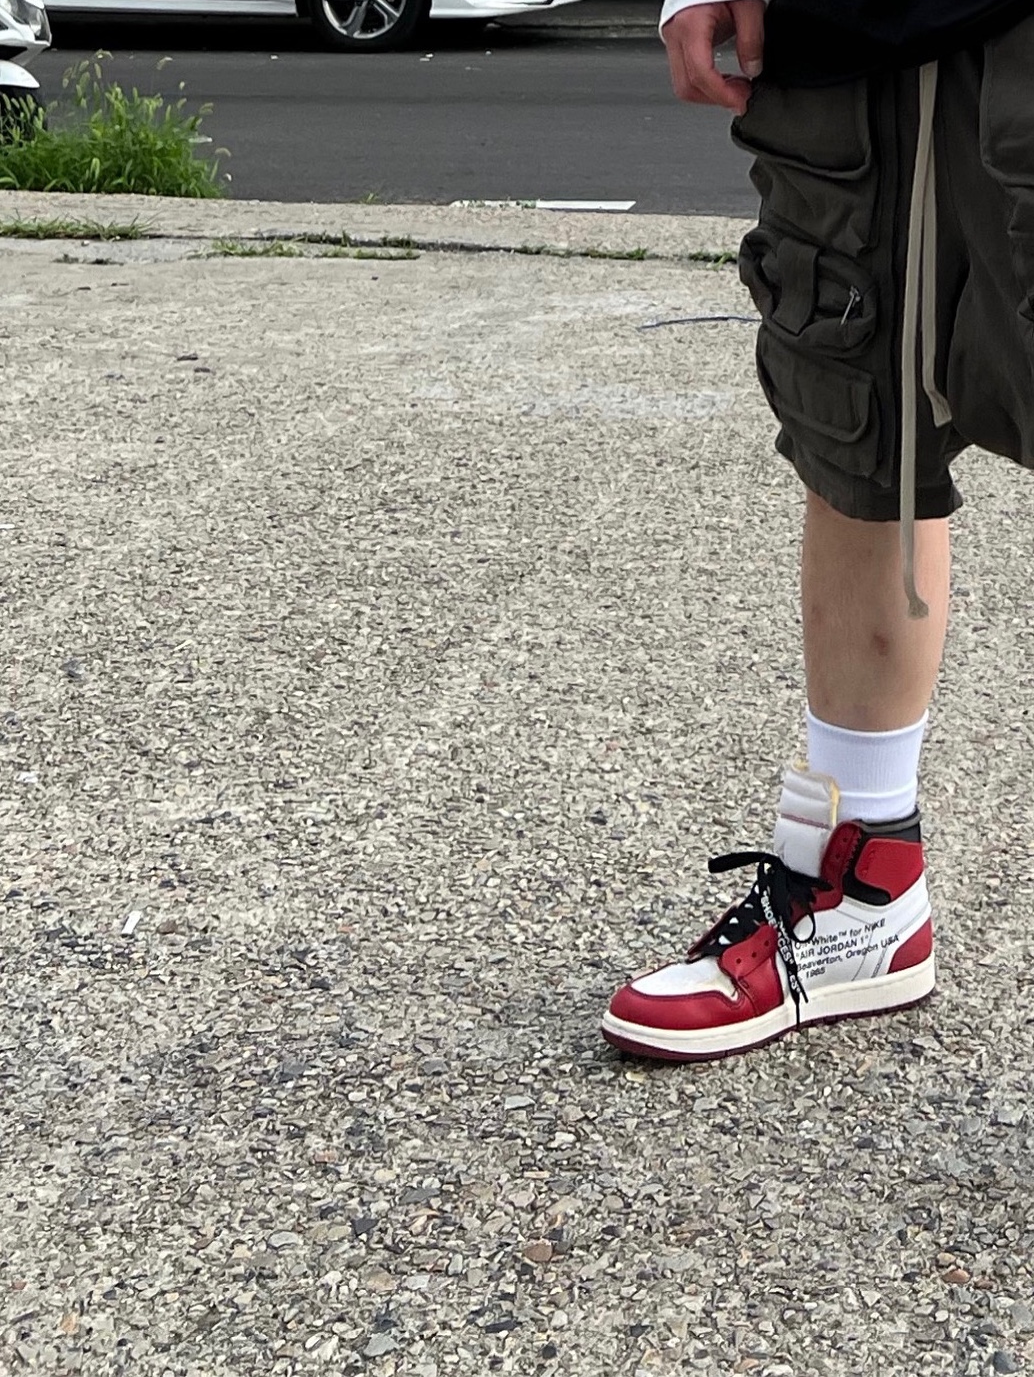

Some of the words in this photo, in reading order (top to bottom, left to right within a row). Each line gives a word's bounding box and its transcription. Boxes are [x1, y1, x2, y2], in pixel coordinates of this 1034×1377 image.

[849, 928, 862, 938] for
[864, 918, 886, 932] NIKE
[817, 938, 858, 956] JORDAN
[845, 943, 879, 959] Oregon
[881, 934, 900, 949] USA
